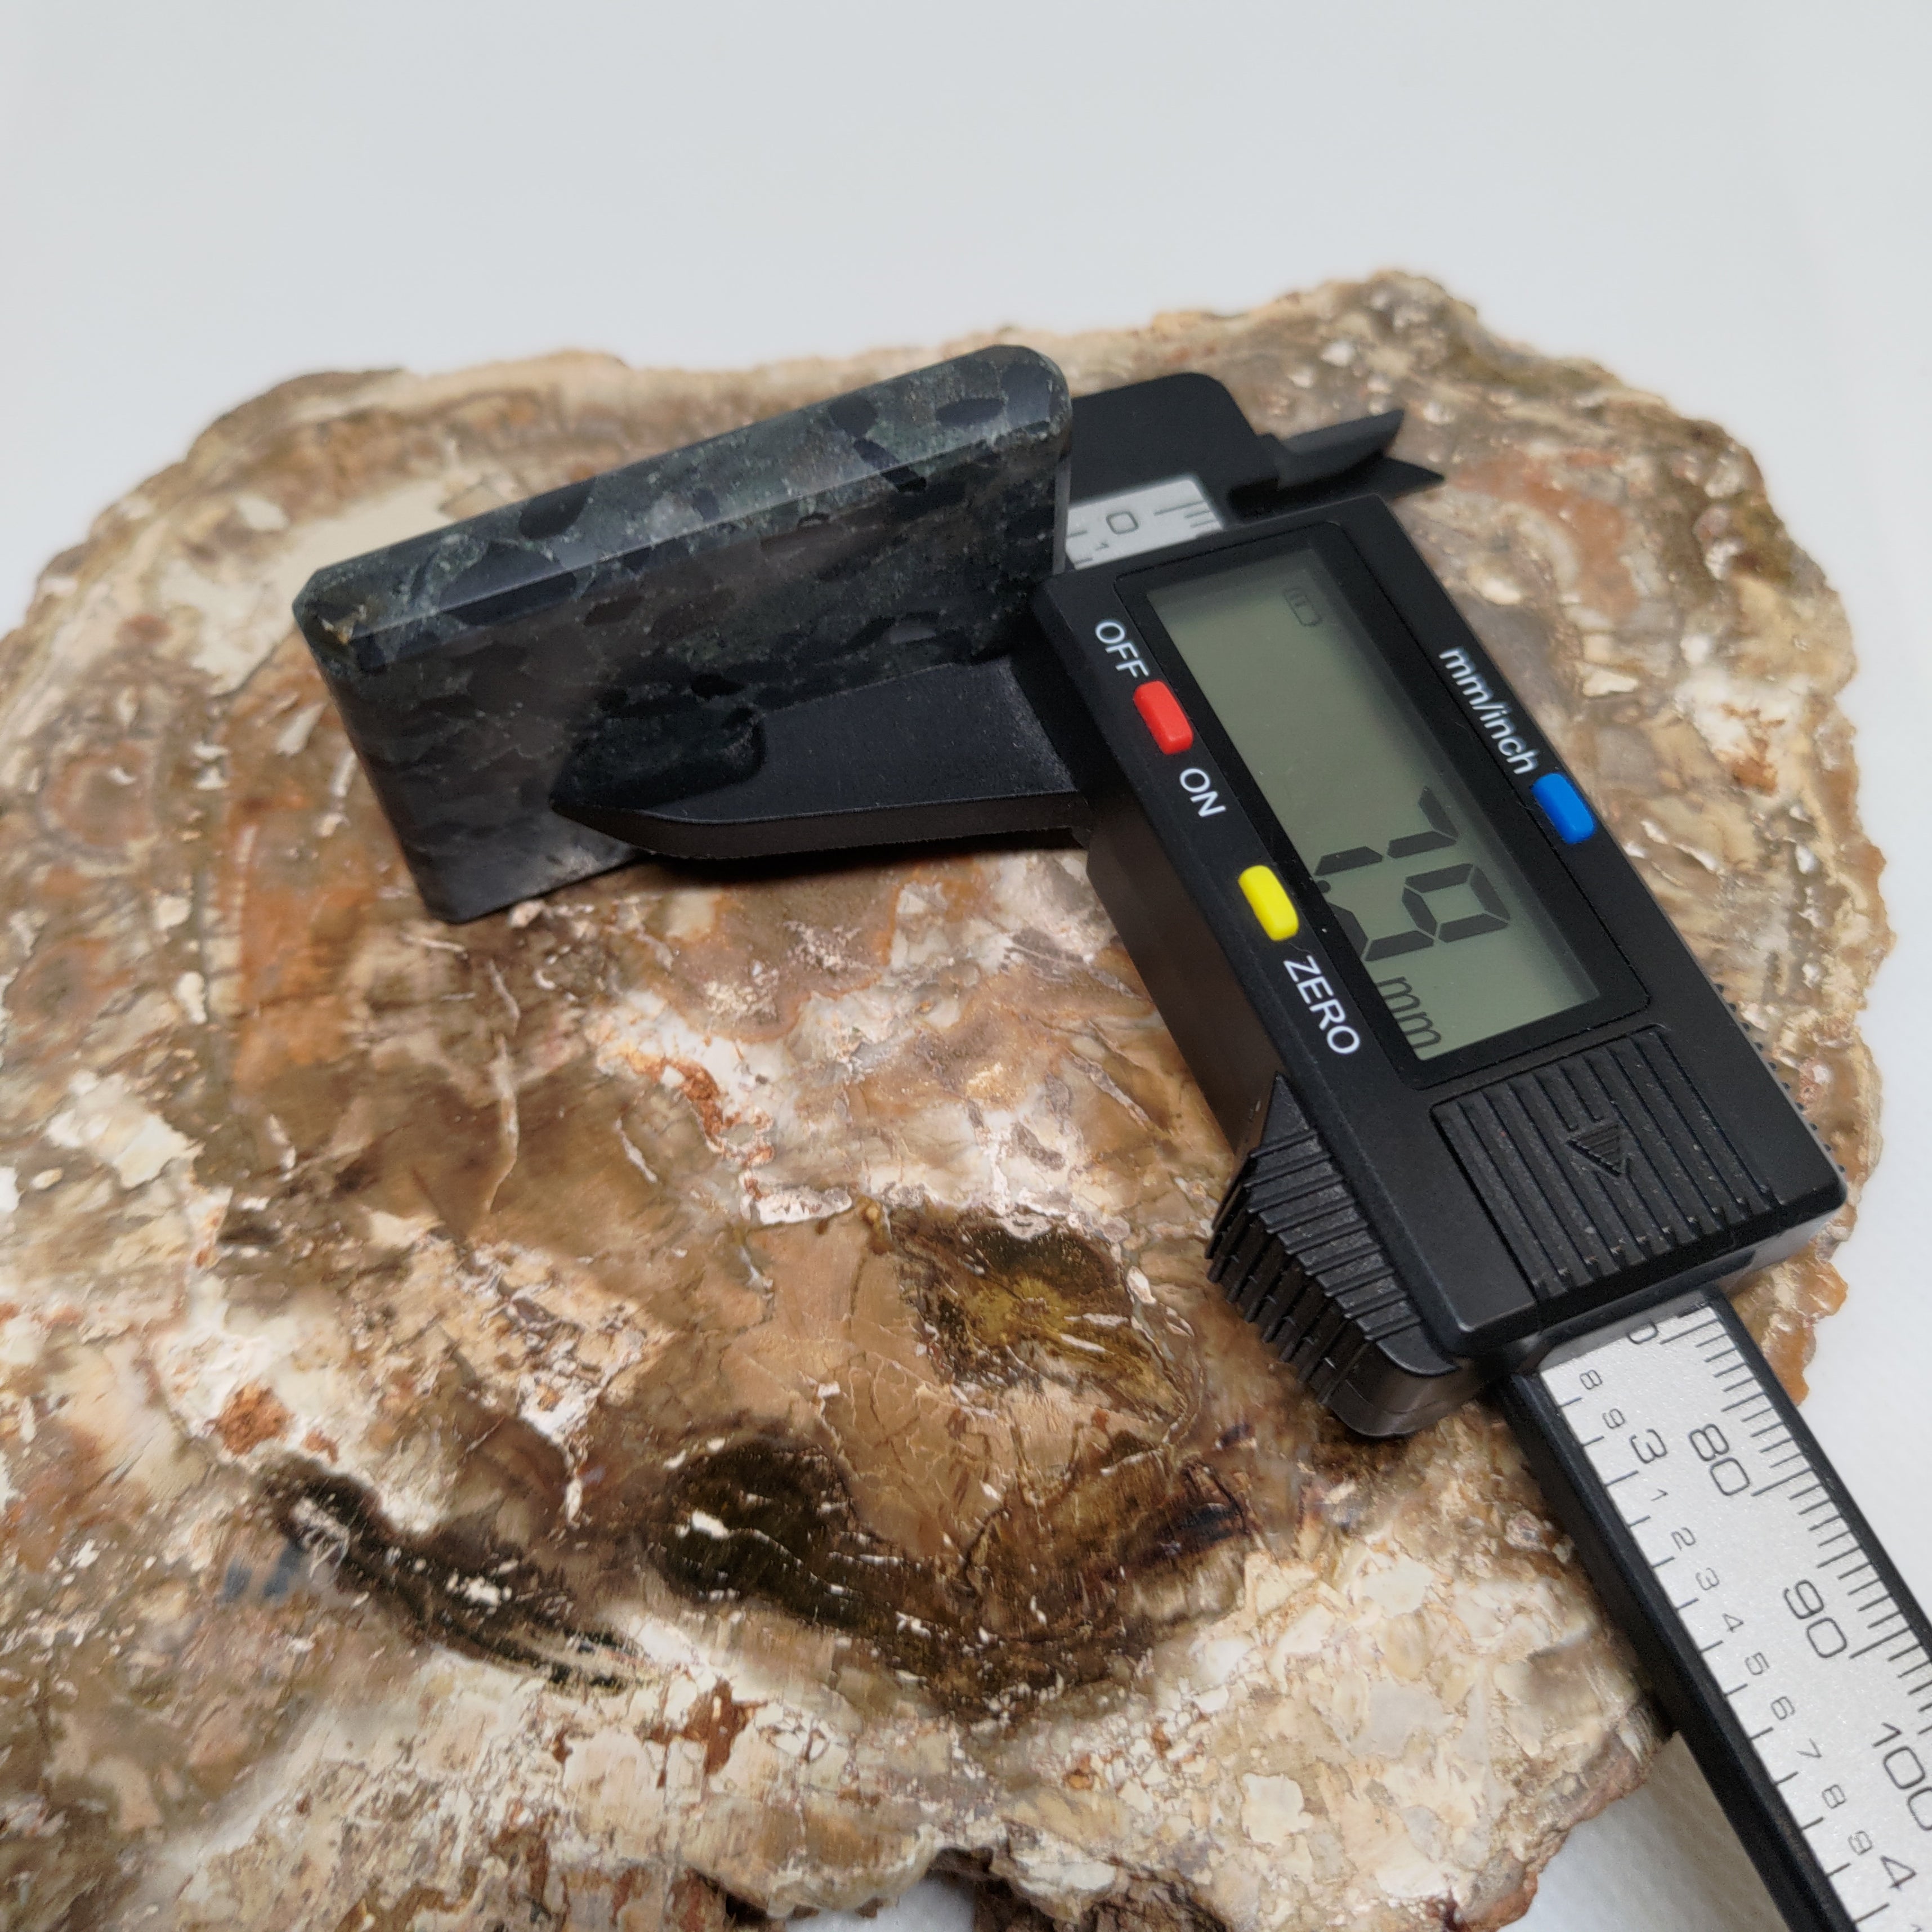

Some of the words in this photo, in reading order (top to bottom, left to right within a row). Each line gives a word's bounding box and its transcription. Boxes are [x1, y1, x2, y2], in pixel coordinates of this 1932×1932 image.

[1106, 510, 1139, 535] 0
[1094, 621, 1150, 678] OFF
[1439, 649, 1538, 775] mm/inch
[1179, 767, 1226, 817] ON
[1313, 786, 1510, 961] 7.9
[1283, 955, 1360, 1054] ZERO
[1375, 976, 1441, 1049] mm
[1579, 1369, 1603, 1390] 8
[1602, 1408, 1626, 1429] 9
[1630, 1429, 1667, 1464] 3
[1688, 1423, 1750, 1496] 80
[1650, 1488, 1669, 1501] 1
[1670, 1526, 1696, 1551] 2
[1694, 1567, 1720, 1591] 3
[1722, 1612, 1745, 1633] 4
[1782, 1579, 1848, 1658] 90
[1745, 1651, 1770, 1675] 5
[1770, 1696, 1796, 1720] 6
[1796, 1738, 1823, 1759] 7
[1821, 1784, 1847, 1810] 8
[1881, 1855, 1917, 1890] 4
